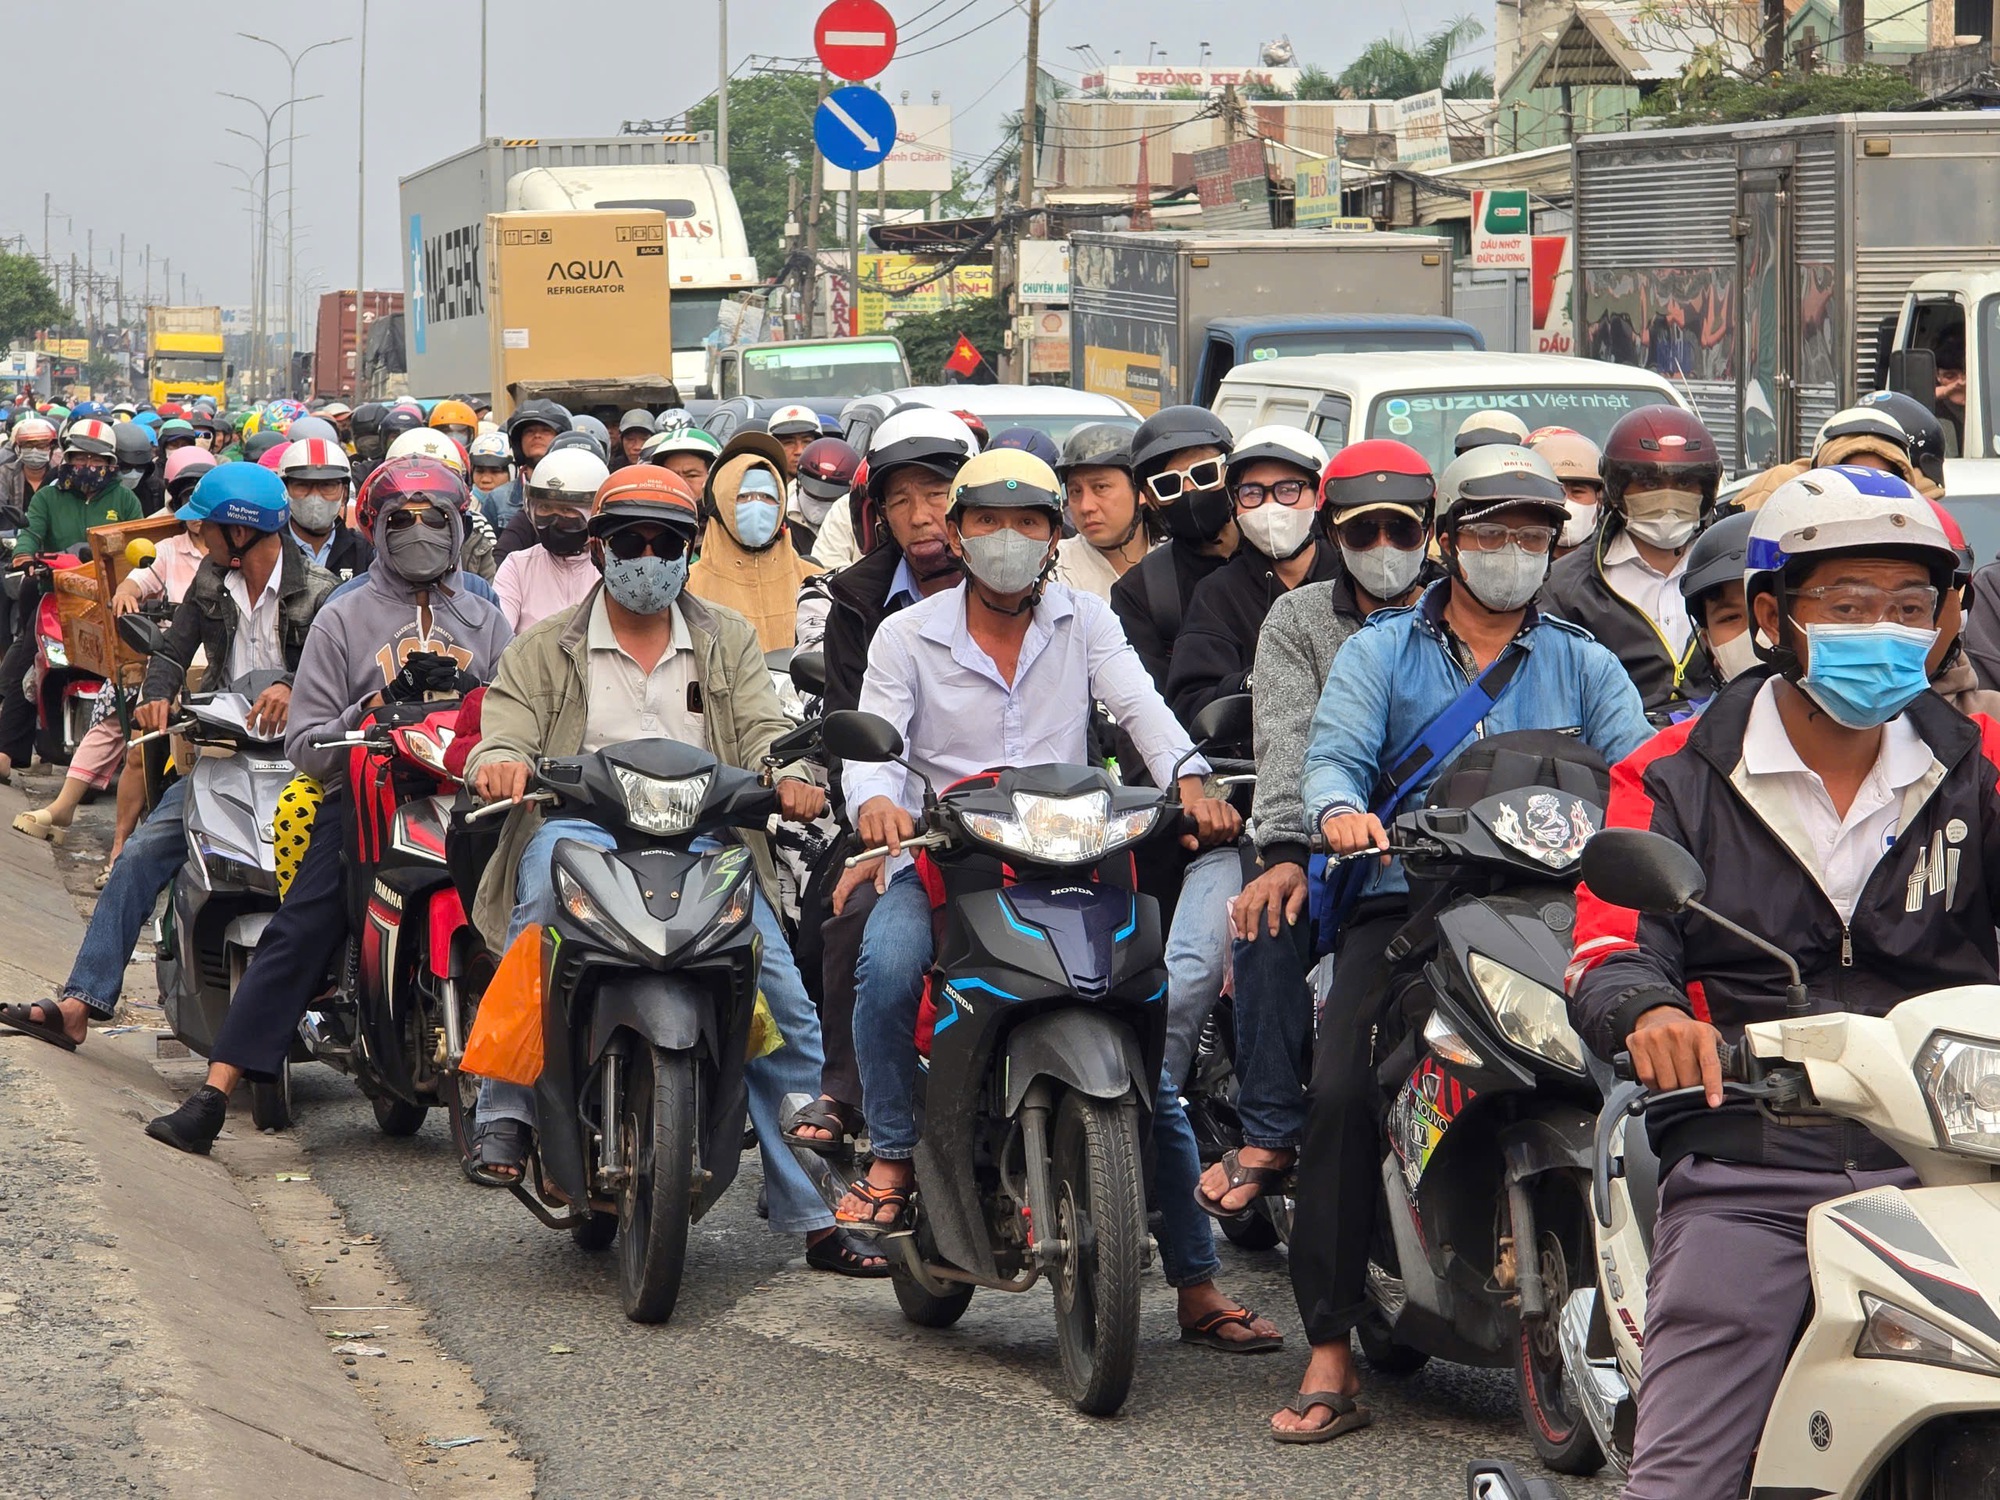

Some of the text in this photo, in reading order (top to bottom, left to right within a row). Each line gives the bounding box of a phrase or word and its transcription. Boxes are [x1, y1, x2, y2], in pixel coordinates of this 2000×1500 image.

[1136, 68, 1202, 86] PHÒNG
[640, 246, 660, 254] BACK
[424, 222, 485, 325] MAERSK
[547, 260, 624, 281] AQUA
[547, 285, 625, 295] REFRIGERATOR
[1410, 392, 1631, 412] SUZUKI Việt nhật
[226, 511, 260, 523] Within You
[228, 504, 260, 516] The Power
[254, 763, 290, 771] HONDA
[640, 849, 677, 857] HONDA
[374, 877, 403, 911] YAMAHA
[1050, 886, 1094, 896] HONDA
[945, 983, 975, 1015] HONDA
[1414, 1096, 1449, 1133] NOUVO
